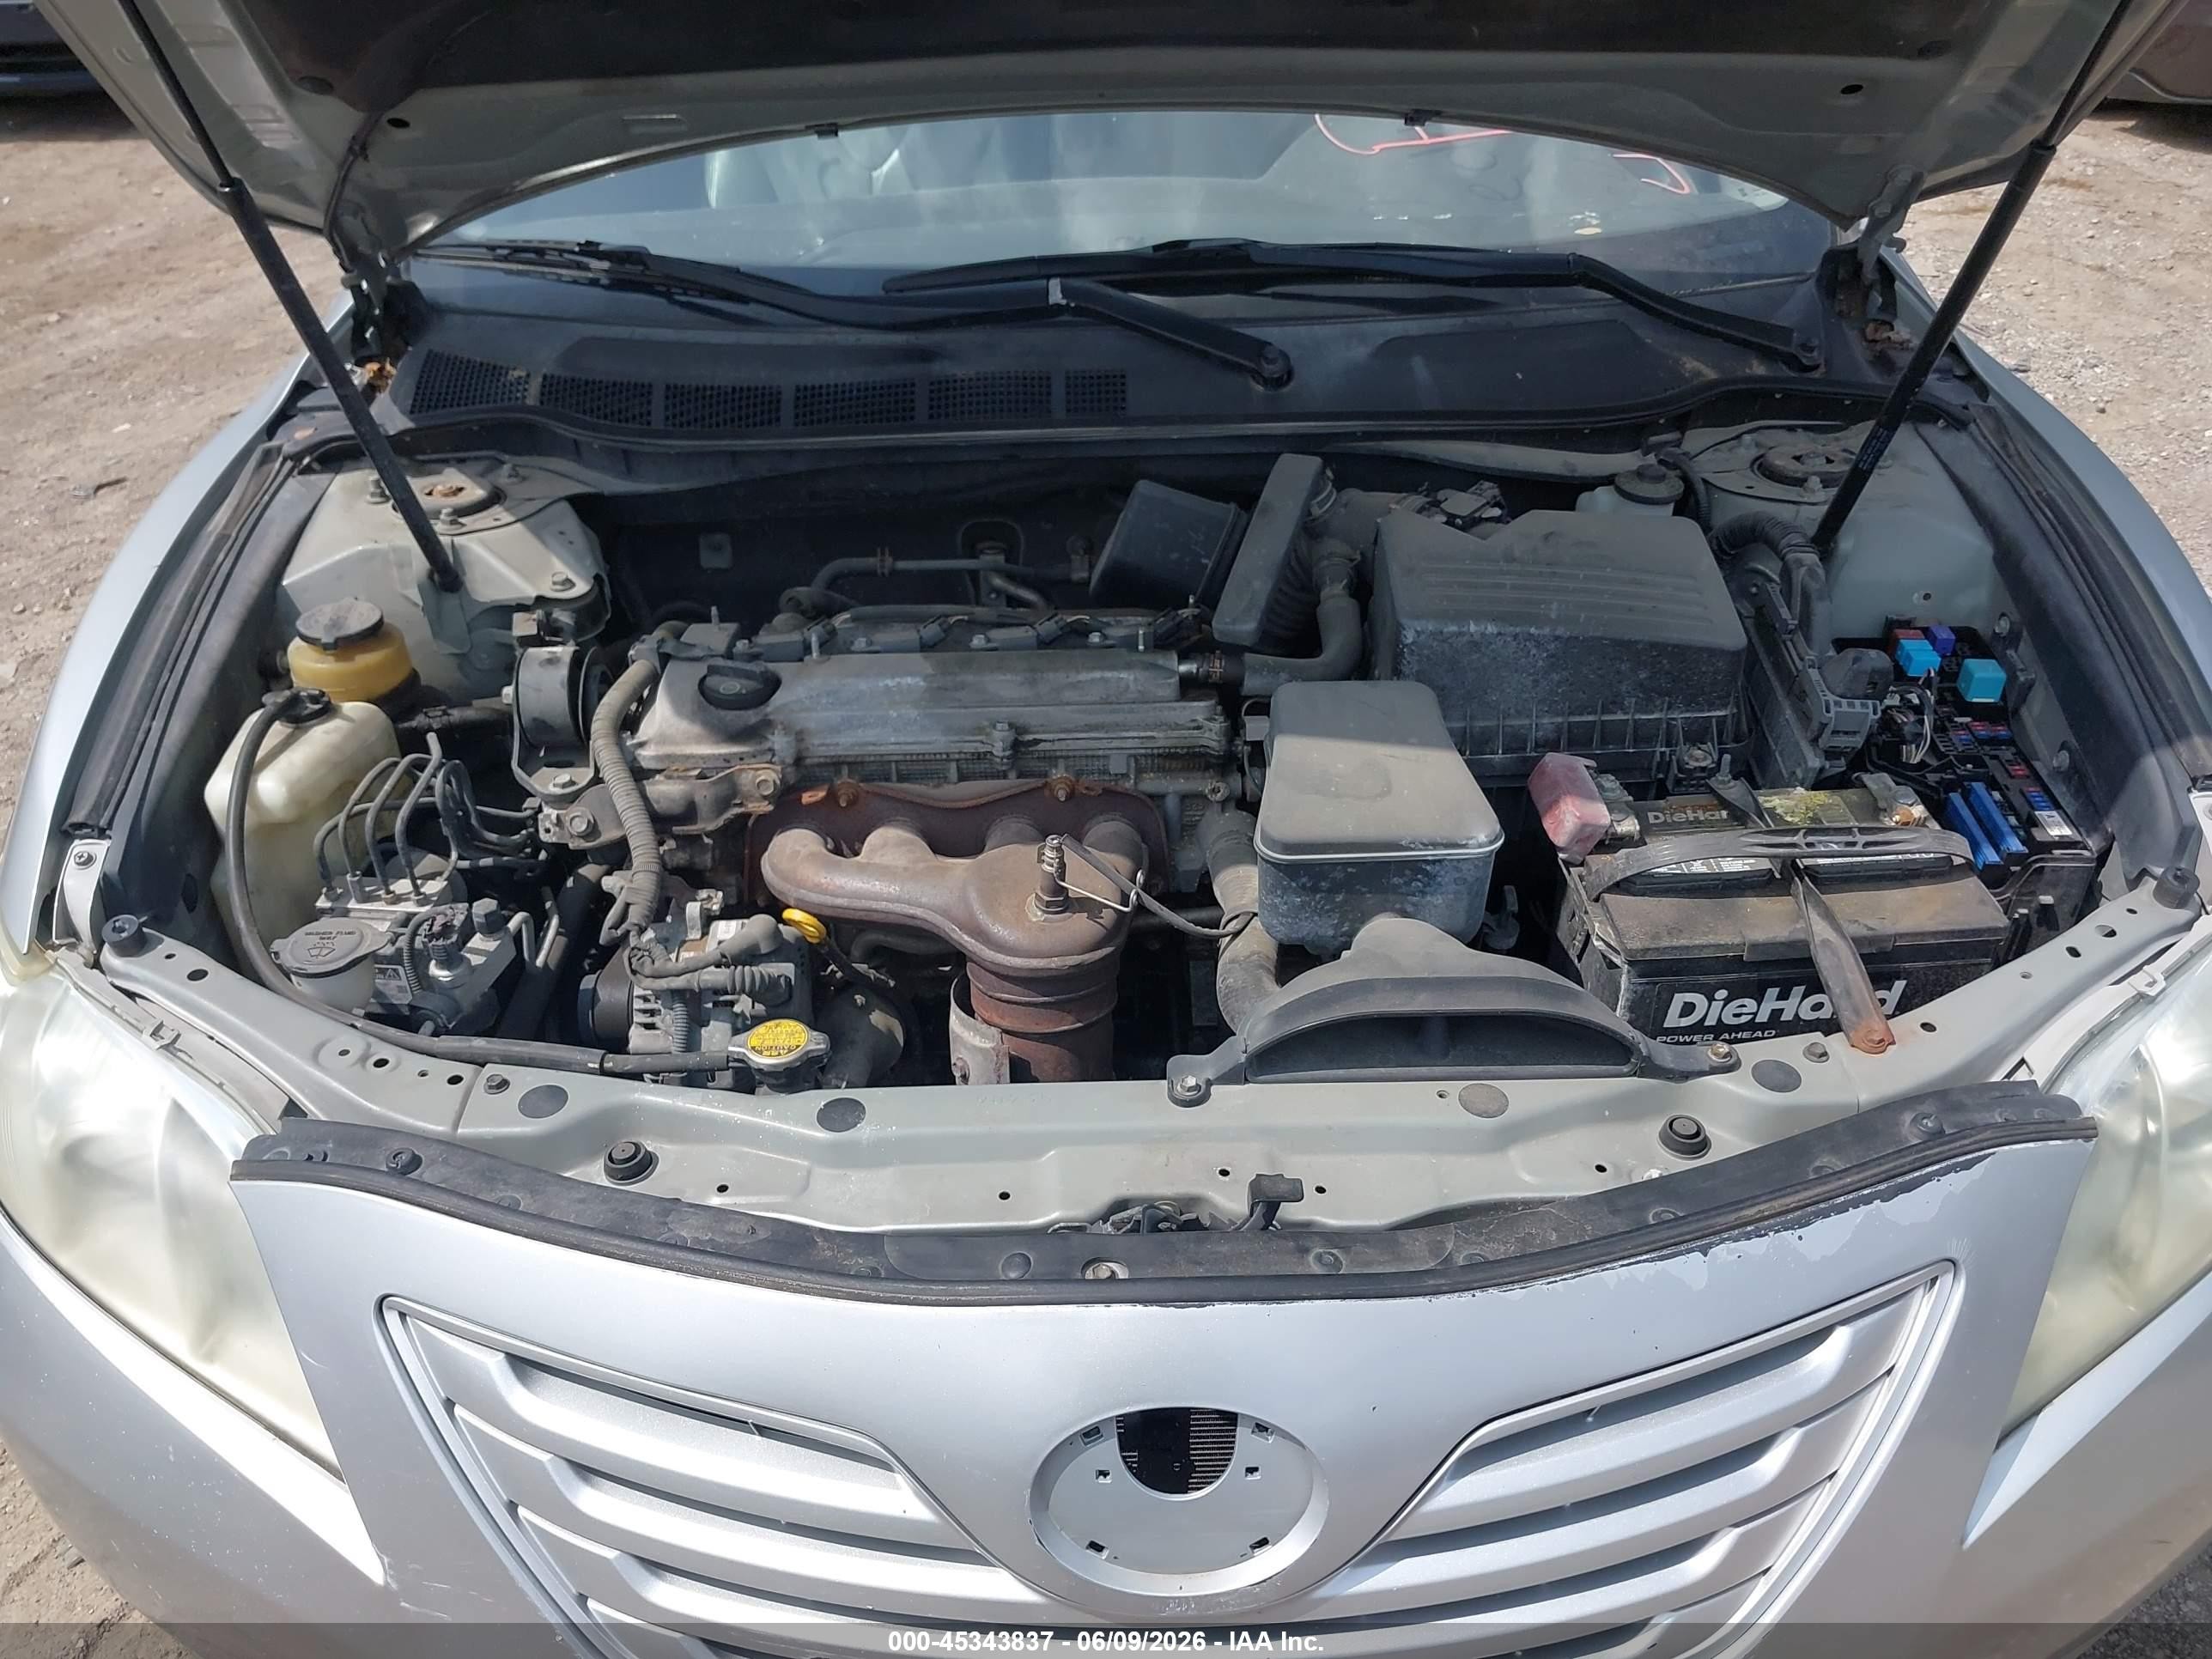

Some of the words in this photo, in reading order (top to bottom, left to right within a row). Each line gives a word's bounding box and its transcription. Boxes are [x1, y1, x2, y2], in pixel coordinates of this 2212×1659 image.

[1648, 810, 1729, 824] DieHar
[1663, 980, 1907, 1028] DieHad
[1656, 1034, 1714, 1043] POWER
[1719, 1030, 1777, 1041] AHEAD
